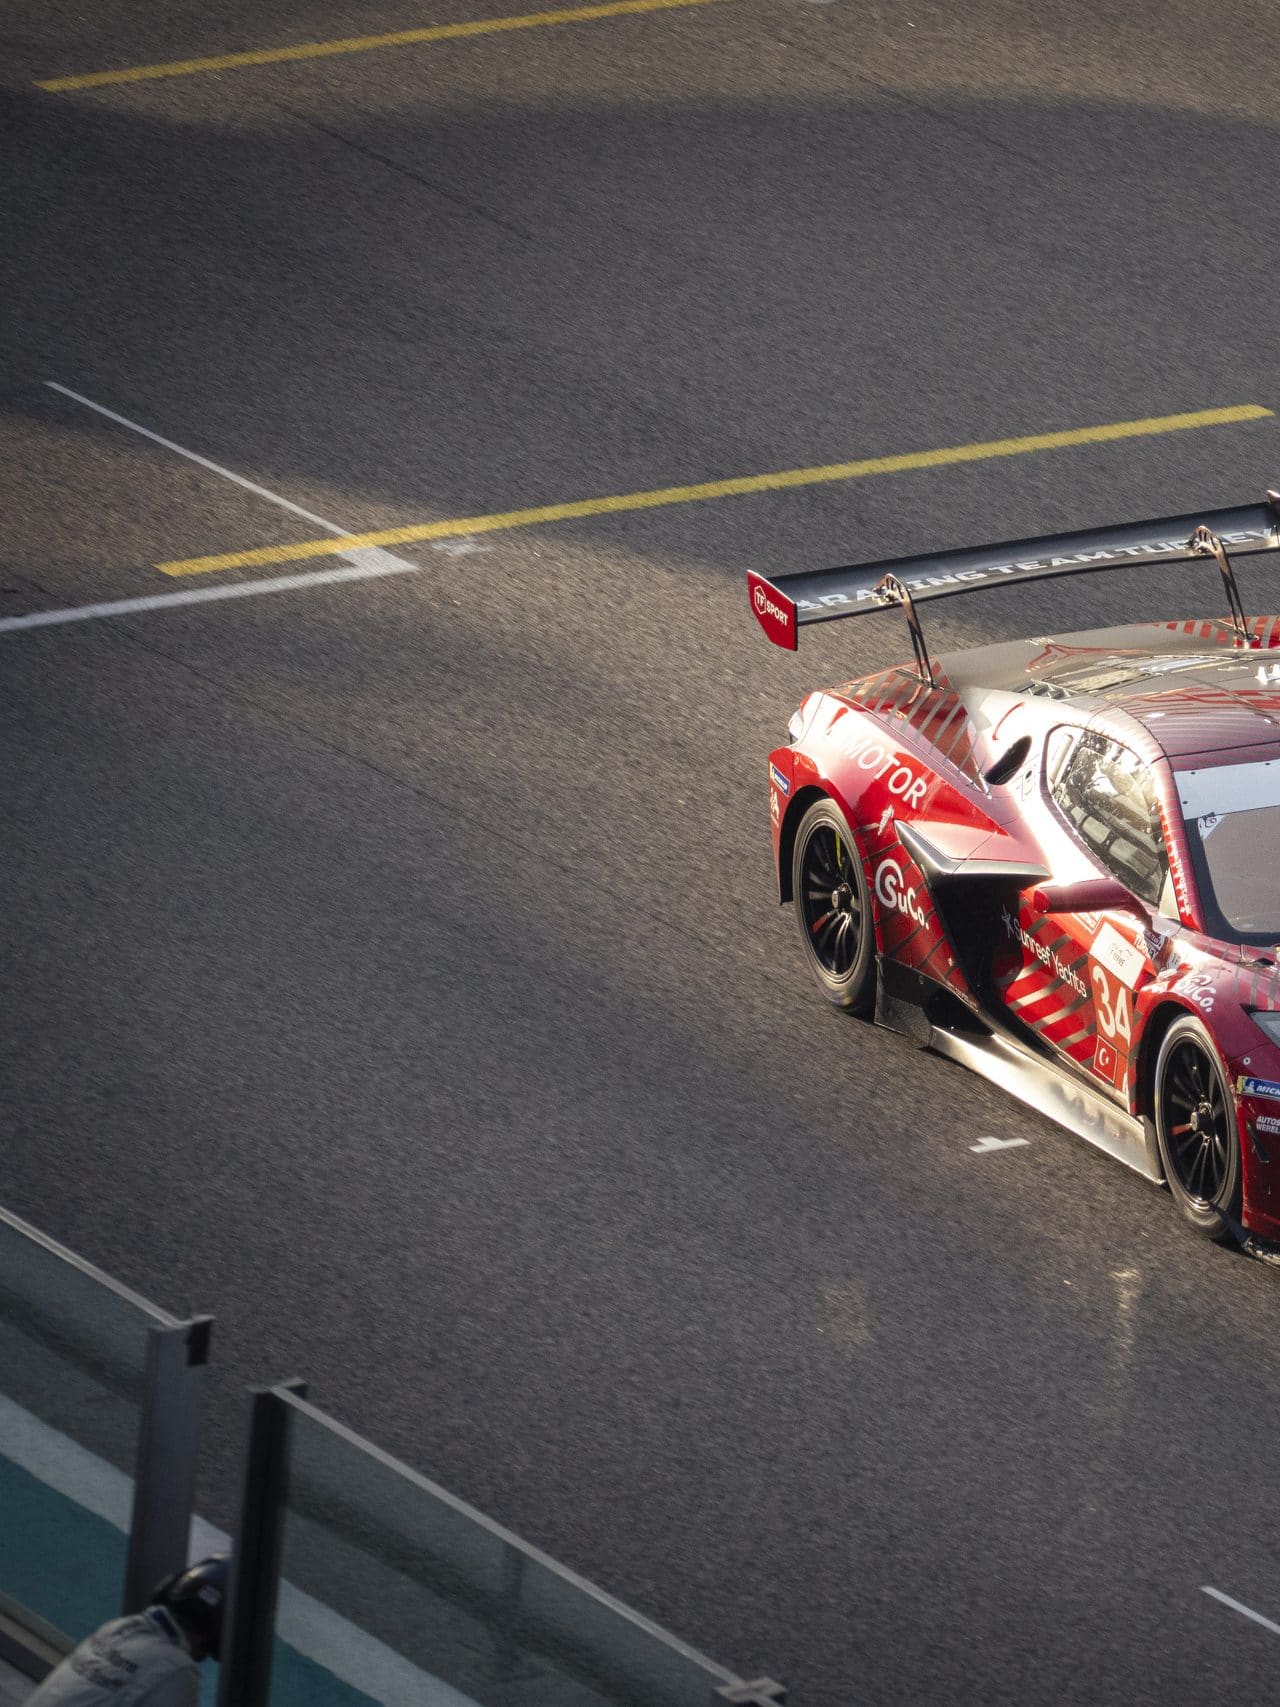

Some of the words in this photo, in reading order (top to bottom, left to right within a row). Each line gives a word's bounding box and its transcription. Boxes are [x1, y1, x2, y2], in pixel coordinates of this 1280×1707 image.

[822, 570, 987, 606] RAING
[988, 551, 1115, 574] TEAM
[766, 600, 788, 626] SPORT
[1013, 919, 1051, 967] Sunreef
[1051, 950, 1088, 998] Yachts
[1093, 965, 1131, 1048] 34
